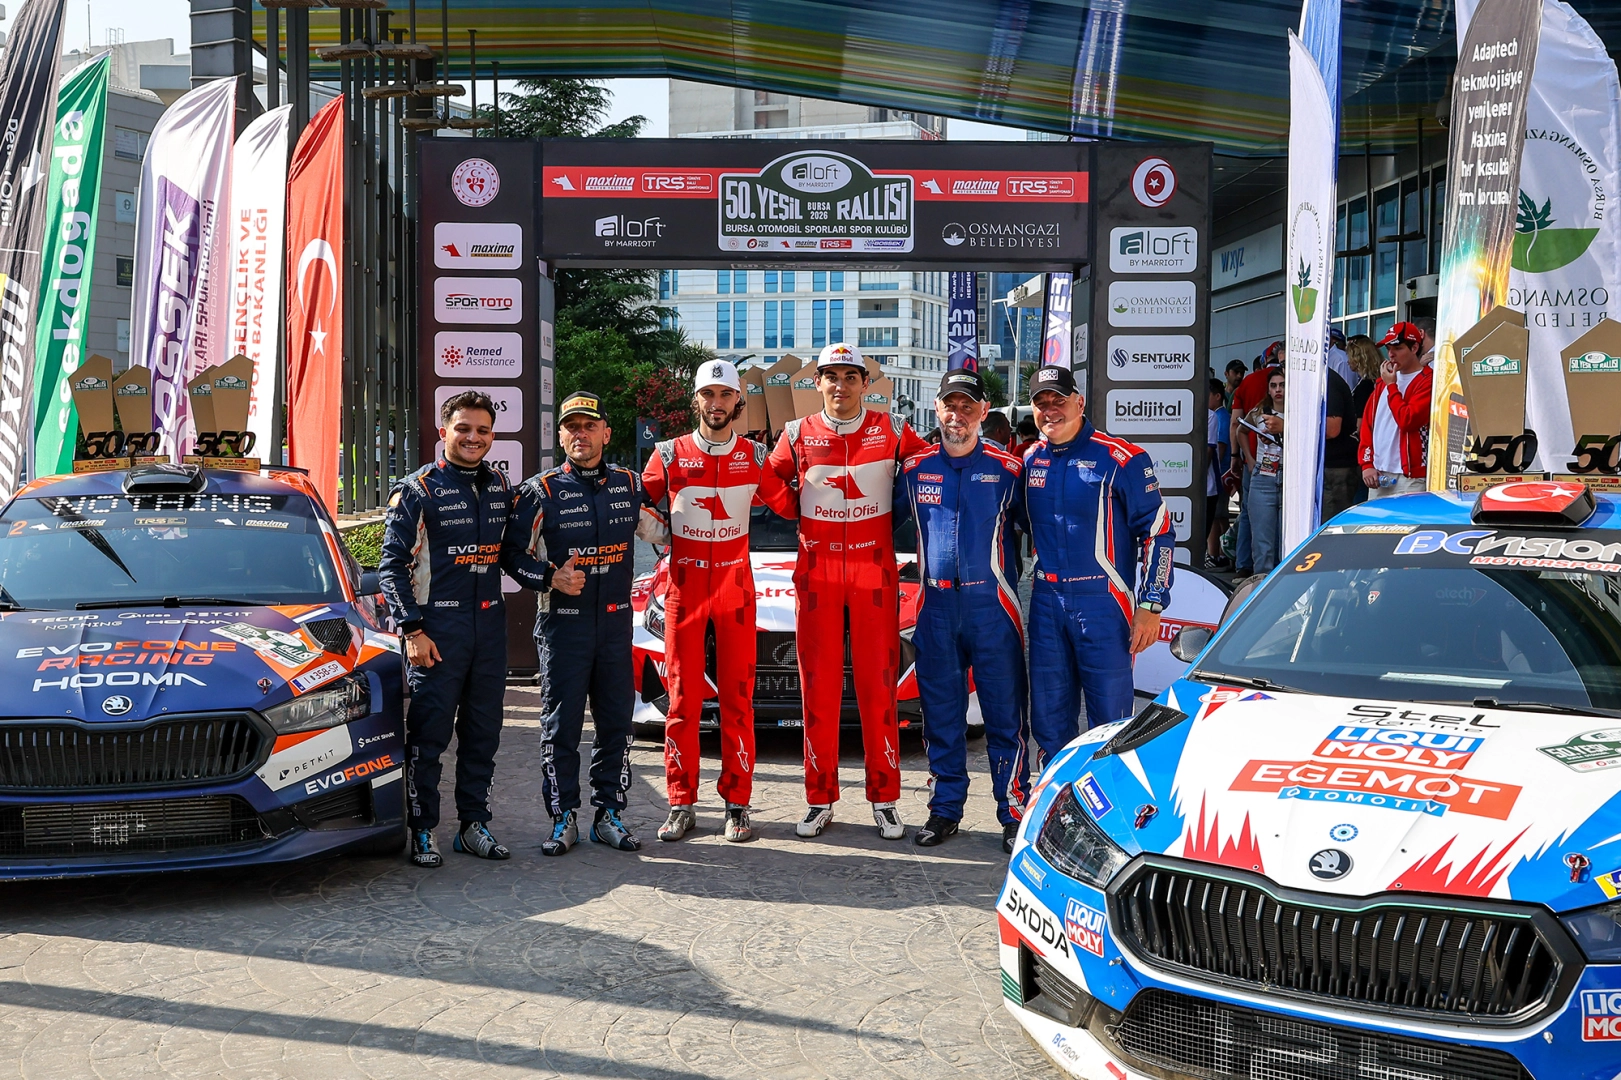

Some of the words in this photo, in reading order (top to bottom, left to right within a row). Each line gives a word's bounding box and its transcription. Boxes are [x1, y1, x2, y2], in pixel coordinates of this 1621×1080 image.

[1472, 38, 1517, 63] Adaptech
[791, 162, 841, 180] aloft
[585, 173, 635, 186] maxima
[645, 176, 685, 190] TRS
[952, 178, 1000, 190] maxima
[1009, 180, 1048, 194] TRS
[725, 180, 756, 220] 50.
[756, 183, 803, 221] YEŞİL
[807, 201, 831, 211] BURSA
[836, 182, 907, 221] RALLİSİ
[810, 211, 829, 220] 2026
[240, 208, 252, 242] VE
[595, 214, 666, 237] aloft
[725, 224, 755, 234] BURSA
[757, 222, 802, 234] OTOMOBİL
[804, 224, 847, 234] SPORLARI
[849, 225, 873, 234] SPOR
[875, 224, 908, 235] KULÜBÜ
[968, 221, 1060, 235] OSMANGAZİ
[470, 242, 515, 253] maxima
[821, 240, 840, 249] TRS
[969, 236, 1060, 248] BELEDİYESİ
[1119, 230, 1194, 255] aloft
[1129, 259, 1140, 267] BY
[1141, 259, 1184, 267] MARRIOTT
[252, 208, 268, 345] BAKANLIĞI
[1130, 296, 1192, 305] OSMANGAZİ
[1131, 306, 1192, 314] BELEDİYESİ
[466, 346, 503, 356] Remed
[465, 356, 515, 367] Assistance
[829, 355, 841, 363] Red
[841, 355, 854, 363] Bull
[248, 351, 261, 417] SPOR
[562, 399, 595, 412] PIRELLI
[1115, 400, 1181, 417] bidijital
[84, 430, 124, 458] 50
[125, 431, 161, 457] 50
[217, 430, 257, 458] 50
[803, 439, 829, 447] KAZAZ
[1112, 449, 1126, 462] OMP
[1162, 459, 1189, 469] Yeşil
[1030, 469, 1047, 478] LIQUI
[1029, 477, 1045, 487] MOLY
[558, 489, 583, 500] Midea
[917, 485, 941, 494] LIQUI
[52, 494, 272, 515] NOTHING
[609, 501, 631, 510] TECNO
[917, 495, 941, 504] MOLY
[814, 505, 850, 518] Petrol
[852, 502, 879, 518] Ofisi
[9, 520, 28, 535] 2
[60, 517, 107, 528] maxima
[245, 517, 289, 528] maxima
[682, 524, 716, 538] Petrol
[718, 523, 741, 538] Ofisi
[568, 542, 628, 556] EVOFONE
[454, 553, 499, 565] RACING
[574, 553, 624, 566] RACING
[721, 557, 744, 567] Silvestre
[1295, 552, 1323, 572] 3
[1468, 556, 1621, 572] MOTORSPOR
[28, 614, 99, 624] TECNO
[44, 620, 123, 631] NOTHING
[15, 640, 237, 659] EVOFONE
[36, 652, 215, 672] RACING
[756, 676, 798, 690] HYU
[1347, 704, 1501, 728] Stel
[365, 736, 381, 744] BLACK
[1338, 725, 1484, 751] LIQUI
[294, 748, 335, 774] PETKIT
[1320, 742, 1474, 770] MOLY
[304, 754, 394, 795] EVOFONE
[1251, 764, 1501, 805] EGEMOT
[1067, 904, 1105, 934] LIQUI
[1066, 921, 1104, 957] MOLY
